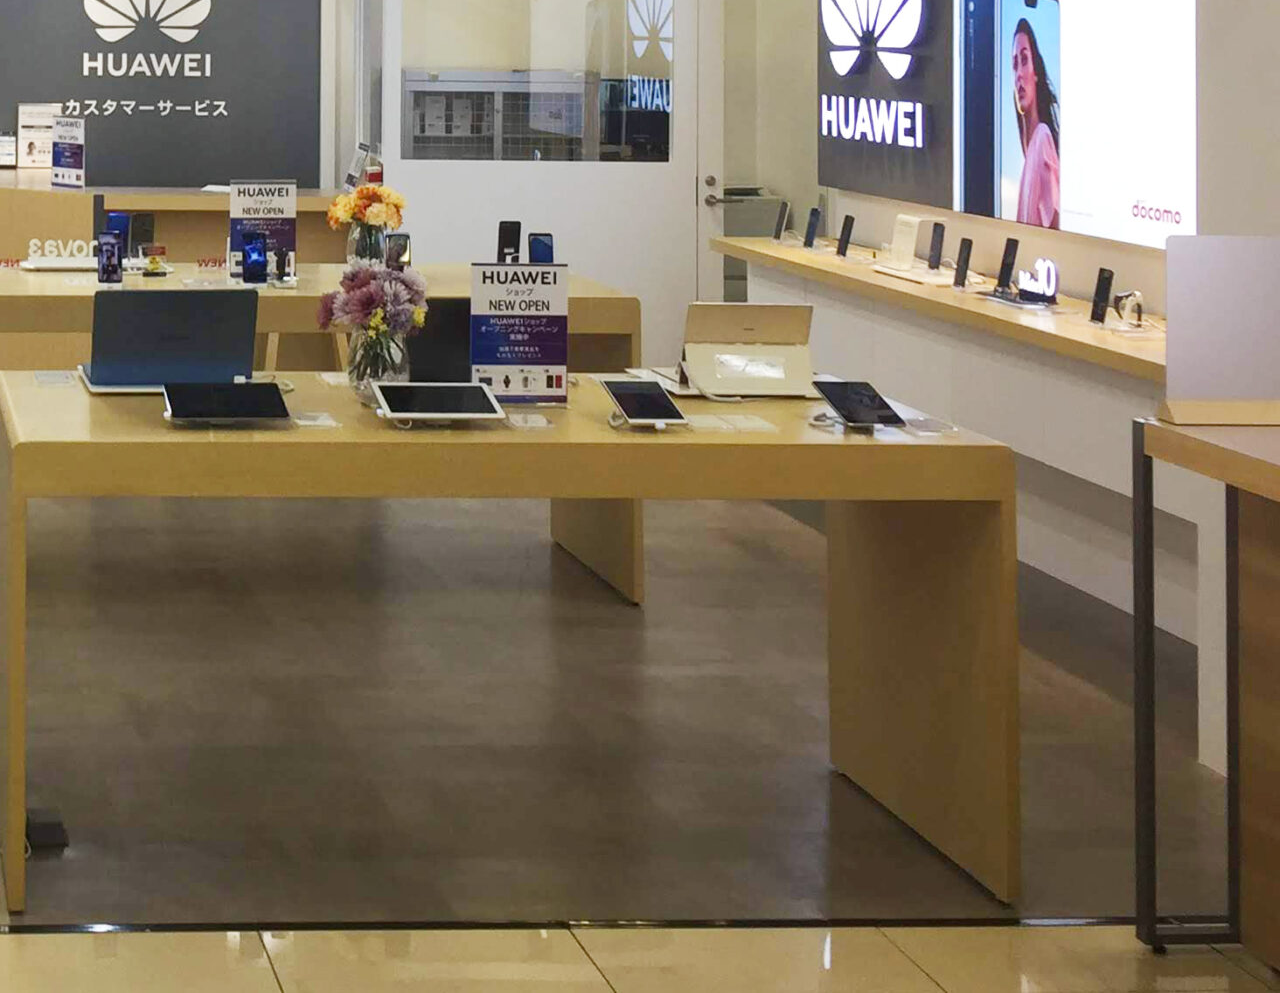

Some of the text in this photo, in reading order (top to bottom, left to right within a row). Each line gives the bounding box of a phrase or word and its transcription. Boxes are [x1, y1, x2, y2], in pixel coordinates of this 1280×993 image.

[83, 53, 212, 77] HUAWEI
[65, 99, 229, 117] カスタマーサービス
[56, 120, 81, 129] HUAWEI
[821, 94, 924, 149] HUAWEI
[238, 187, 289, 197] HUAWEI
[263, 208, 284, 216] OPEN
[1132, 202, 1181, 224] docomo
[482, 270, 557, 285] HUAWEI
[505, 288, 534, 296] ショップ
[489, 300, 550, 312] NEW OPEN
